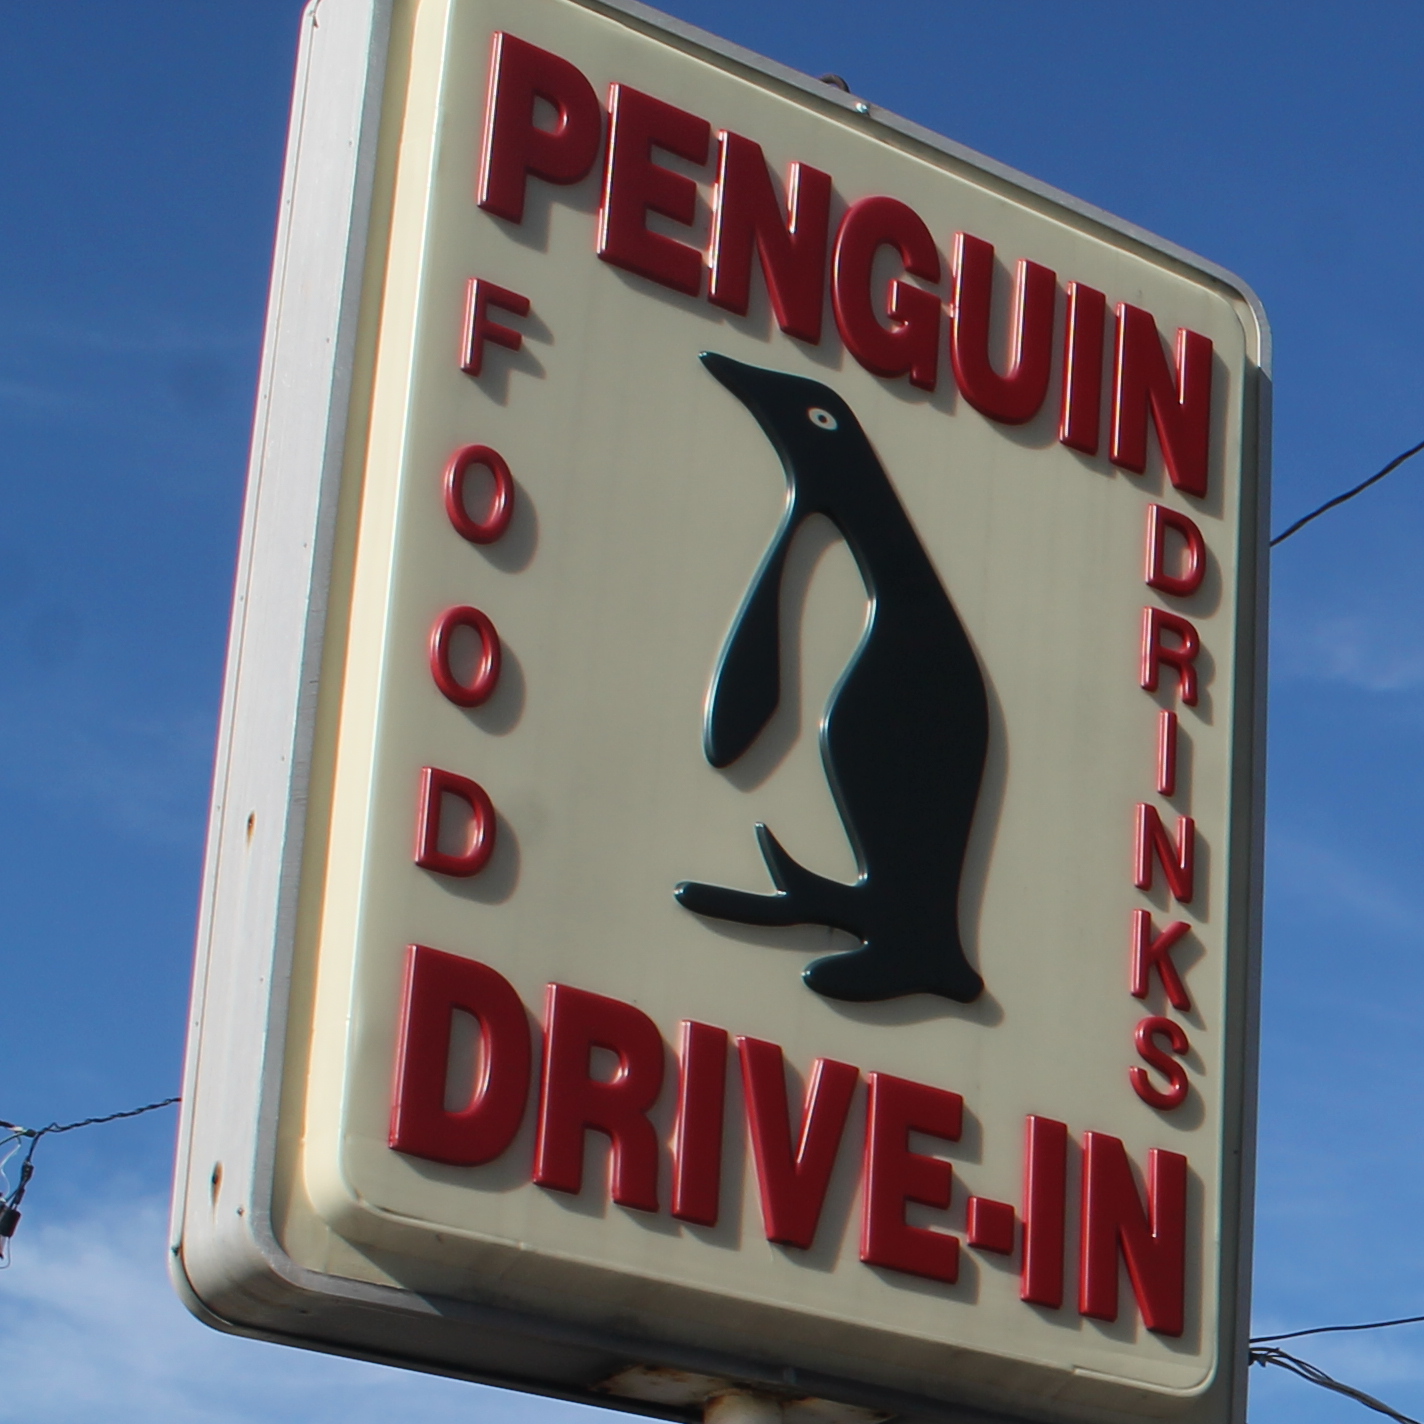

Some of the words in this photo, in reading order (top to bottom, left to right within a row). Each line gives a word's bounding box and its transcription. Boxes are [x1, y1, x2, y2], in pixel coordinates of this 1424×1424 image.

[476, 31, 1213, 497] PENGUIN
[413, 278, 530, 878] FOOD
[1128, 502, 1205, 1111] DRINKS
[389, 943, 1188, 1336] DRIVE-IN
